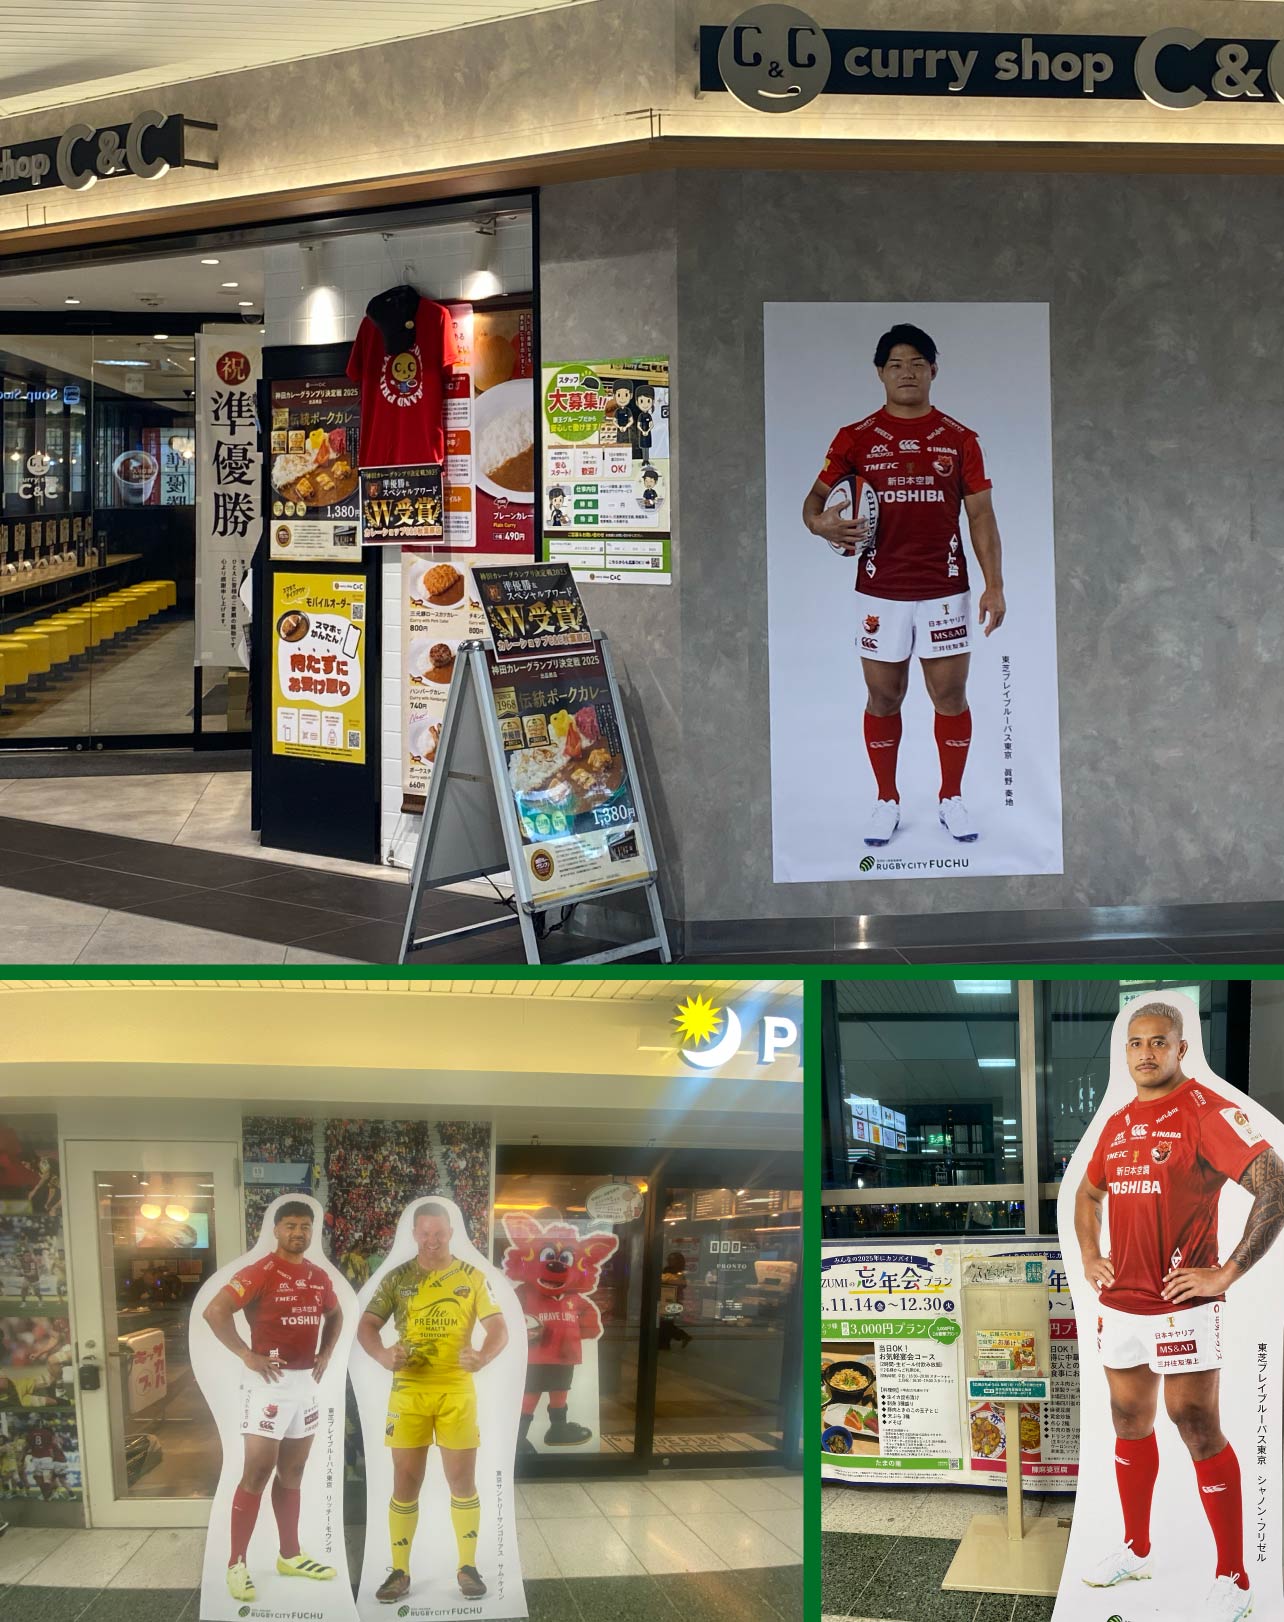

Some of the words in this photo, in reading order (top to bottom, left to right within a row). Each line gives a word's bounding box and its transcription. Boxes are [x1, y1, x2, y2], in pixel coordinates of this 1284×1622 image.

[844, 45, 978, 91] curry
[994, 38, 1114, 92] shop
[1134, 27, 1284, 110] C&
[221, 355, 247, 381] 祝
[558, 376, 579, 384] スタッフ
[209, 390, 257, 537] 準優勝
[611, 464, 627, 473] OK!
[887, 475, 934, 487] 新日本空調
[382, 486, 438, 496] スペシャルアワード
[877, 490, 945, 503] TOSHIBA
[371, 496, 436, 527] W受賞
[493, 511, 534, 520] プレーンカレー
[506, 587, 573, 600] スペシャルアワード
[306, 596, 351, 608] モバイルオーダー
[495, 599, 582, 636] W受賞
[409, 624, 428, 632] 800円
[933, 627, 966, 640] MS&AD
[290, 652, 349, 676] 待たずに
[491, 658, 581, 676] 神田カレーグランプリ決定戦
[582, 656, 600, 666] 2025
[288, 676, 351, 697] お受け取り
[519, 686, 609, 710] 伝統ポークカレー
[409, 781, 426, 789] 660円
[593, 805, 635, 825] 1,380円
[929, 858, 969, 868] FUCHU
[762, 1016, 798, 1062] P
[1156, 1131, 1182, 1139] INABA
[1116, 1164, 1151, 1177] 新日本空調
[1108, 1180, 1162, 1195] TOSHIBA
[1048, 1269, 1070, 1293] 年
[414, 1318, 459, 1326] PREMIUM
[538, 1312, 561, 1321] BRAVE
[1154, 1328, 1195, 1340] 日本キヤリア
[1159, 1343, 1194, 1354] MS&AD
[1257, 1342, 1267, 1465] 東芝ブレイブルーパス東京
[1256, 1475, 1267, 1562] シャノン・フリゼル
[291, 1611, 323, 1619] FUCHU
[451, 1607, 483, 1615] FUCHU
